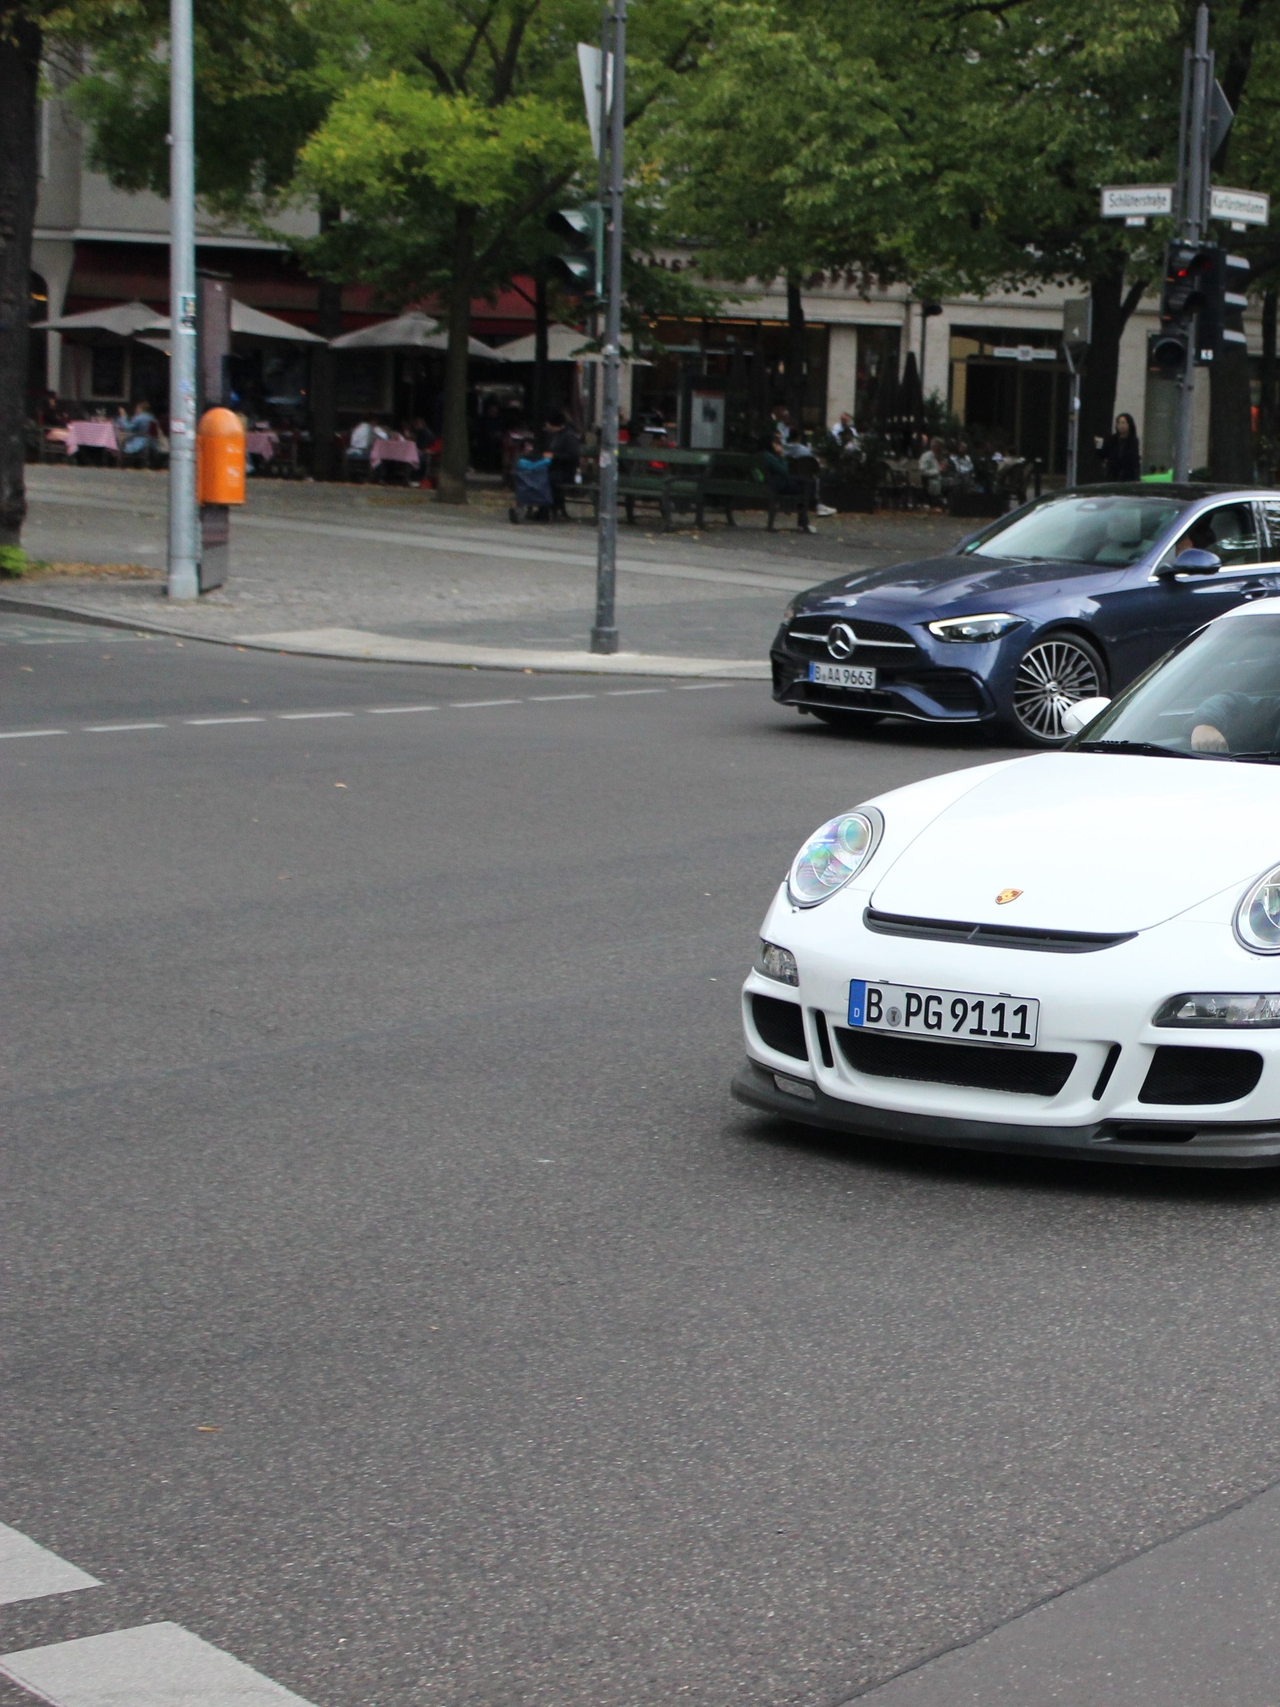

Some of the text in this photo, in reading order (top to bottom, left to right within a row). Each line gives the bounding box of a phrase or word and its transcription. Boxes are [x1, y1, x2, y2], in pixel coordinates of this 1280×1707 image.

[815, 665, 873, 686] B AA 9663
[853, 1007, 860, 1018] D
[866, 987, 1031, 1041] B PG 9111
